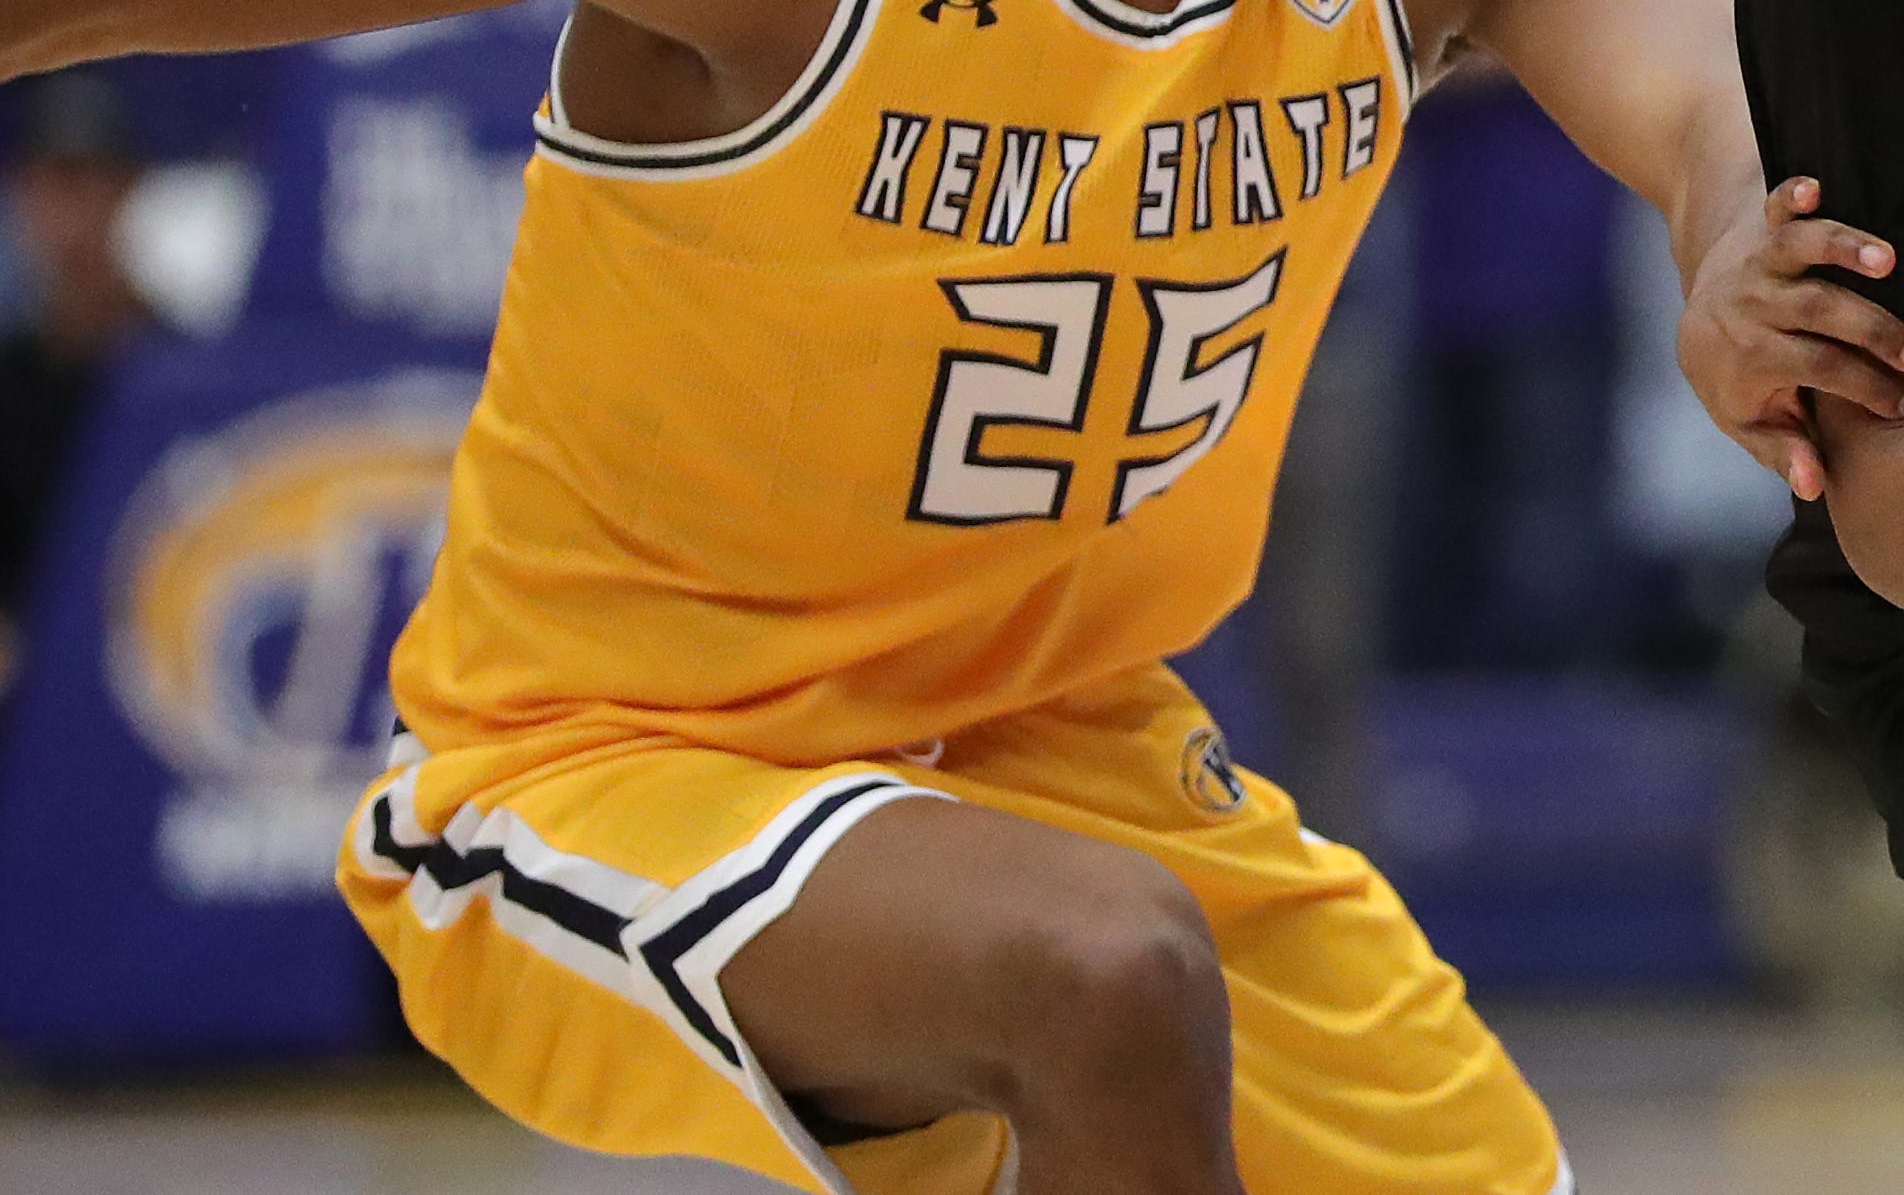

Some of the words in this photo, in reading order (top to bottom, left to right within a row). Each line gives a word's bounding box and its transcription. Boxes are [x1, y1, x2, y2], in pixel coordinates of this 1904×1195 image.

[855, 109, 1100, 246] KENT
[1135, 74, 1382, 239] STATE
[905, 245, 1288, 525] 25
